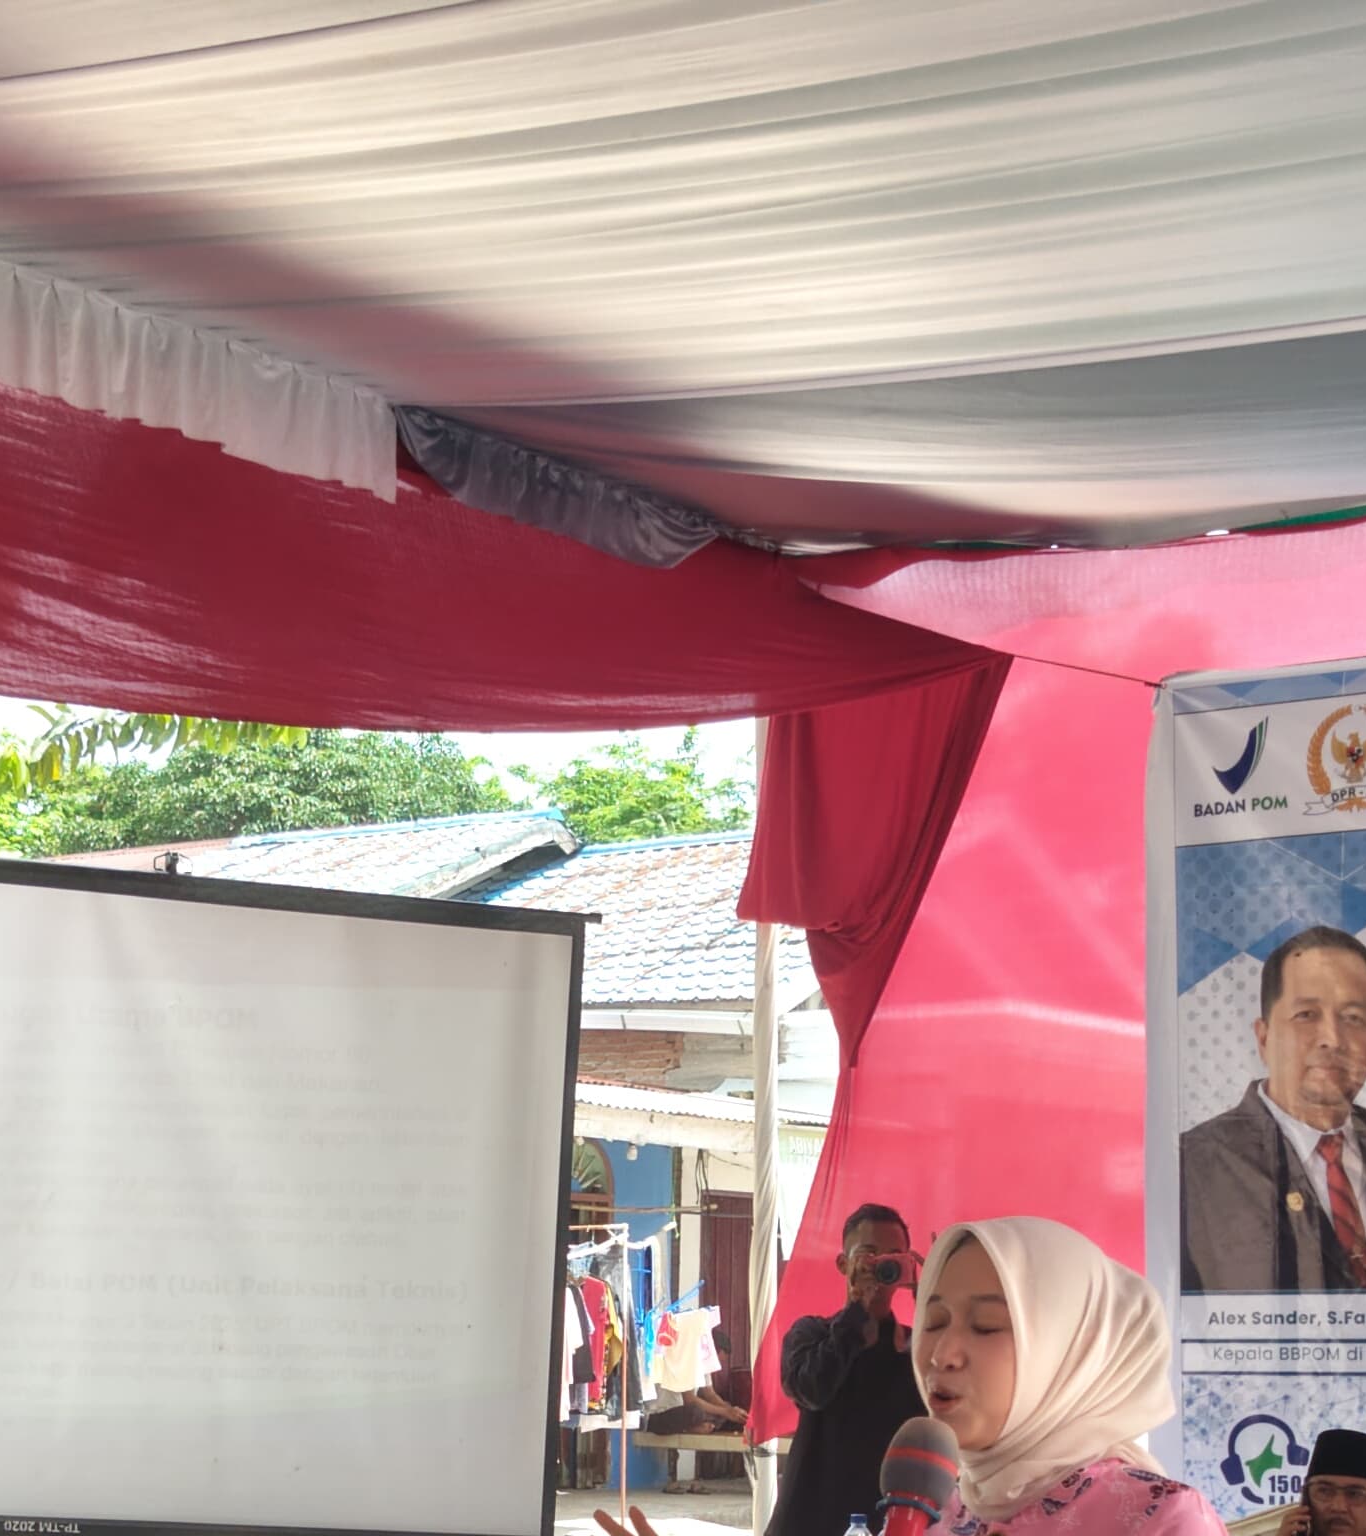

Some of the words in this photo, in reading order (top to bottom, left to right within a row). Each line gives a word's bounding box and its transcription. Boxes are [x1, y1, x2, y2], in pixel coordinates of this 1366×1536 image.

[1194, 799, 1246, 818] BADAN
[1251, 796, 1288, 811] POM
[1208, 1311, 1247, 1325] Alex
[1251, 1311, 1323, 1328] Sander,
[1212, 1346, 1274, 1366] Kepala
[1279, 1347, 1340, 1362] BBPOM
[1346, 1346, 1364, 1361] di
[1268, 1474, 1302, 1493] 150
[3, 1519, 36, 1532] 2020
